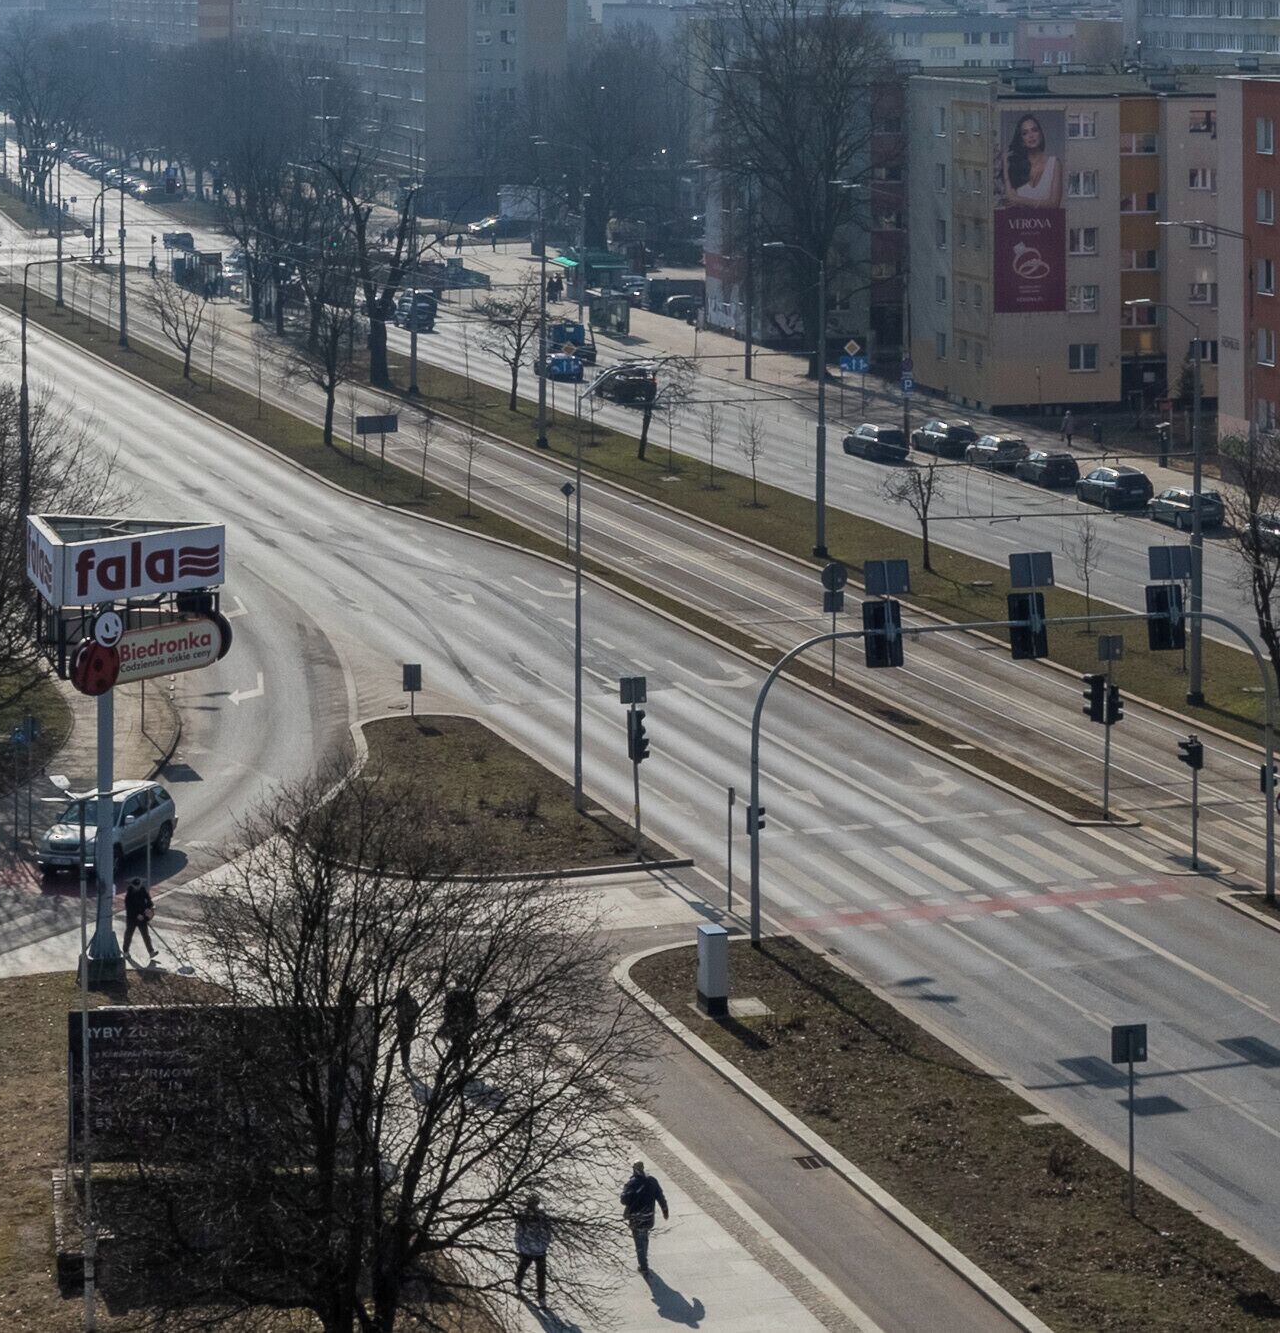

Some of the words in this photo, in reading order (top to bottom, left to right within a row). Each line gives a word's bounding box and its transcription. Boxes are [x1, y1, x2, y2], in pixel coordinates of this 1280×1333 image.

[1008, 218, 1051, 230] VERONA
[75, 541, 175, 597] fala
[120, 631, 212, 662] Biedronka
[120, 656, 166, 674] Codziennie
[166, 650, 191, 666] niskie
[192, 649, 212, 662] ceny
